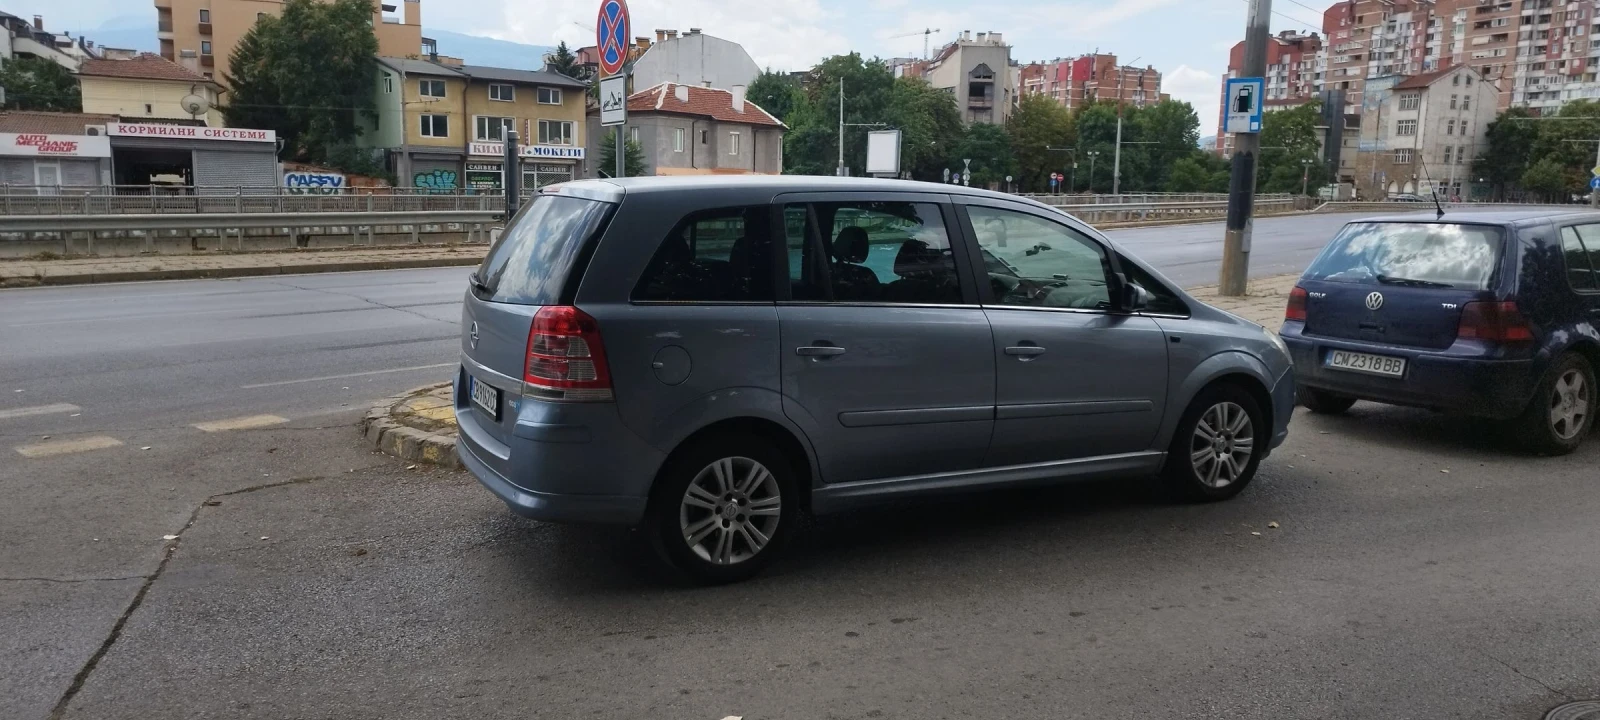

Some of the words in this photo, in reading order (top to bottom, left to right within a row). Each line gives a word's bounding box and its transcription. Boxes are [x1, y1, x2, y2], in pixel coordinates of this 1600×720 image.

[118, 124, 196, 136] КОРМИЛНИ
[204, 129, 267, 139] СИСТЕМИ
[15, 139, 79, 147] MECHANIC
[533, 147, 581, 157] МОКЕТИ
